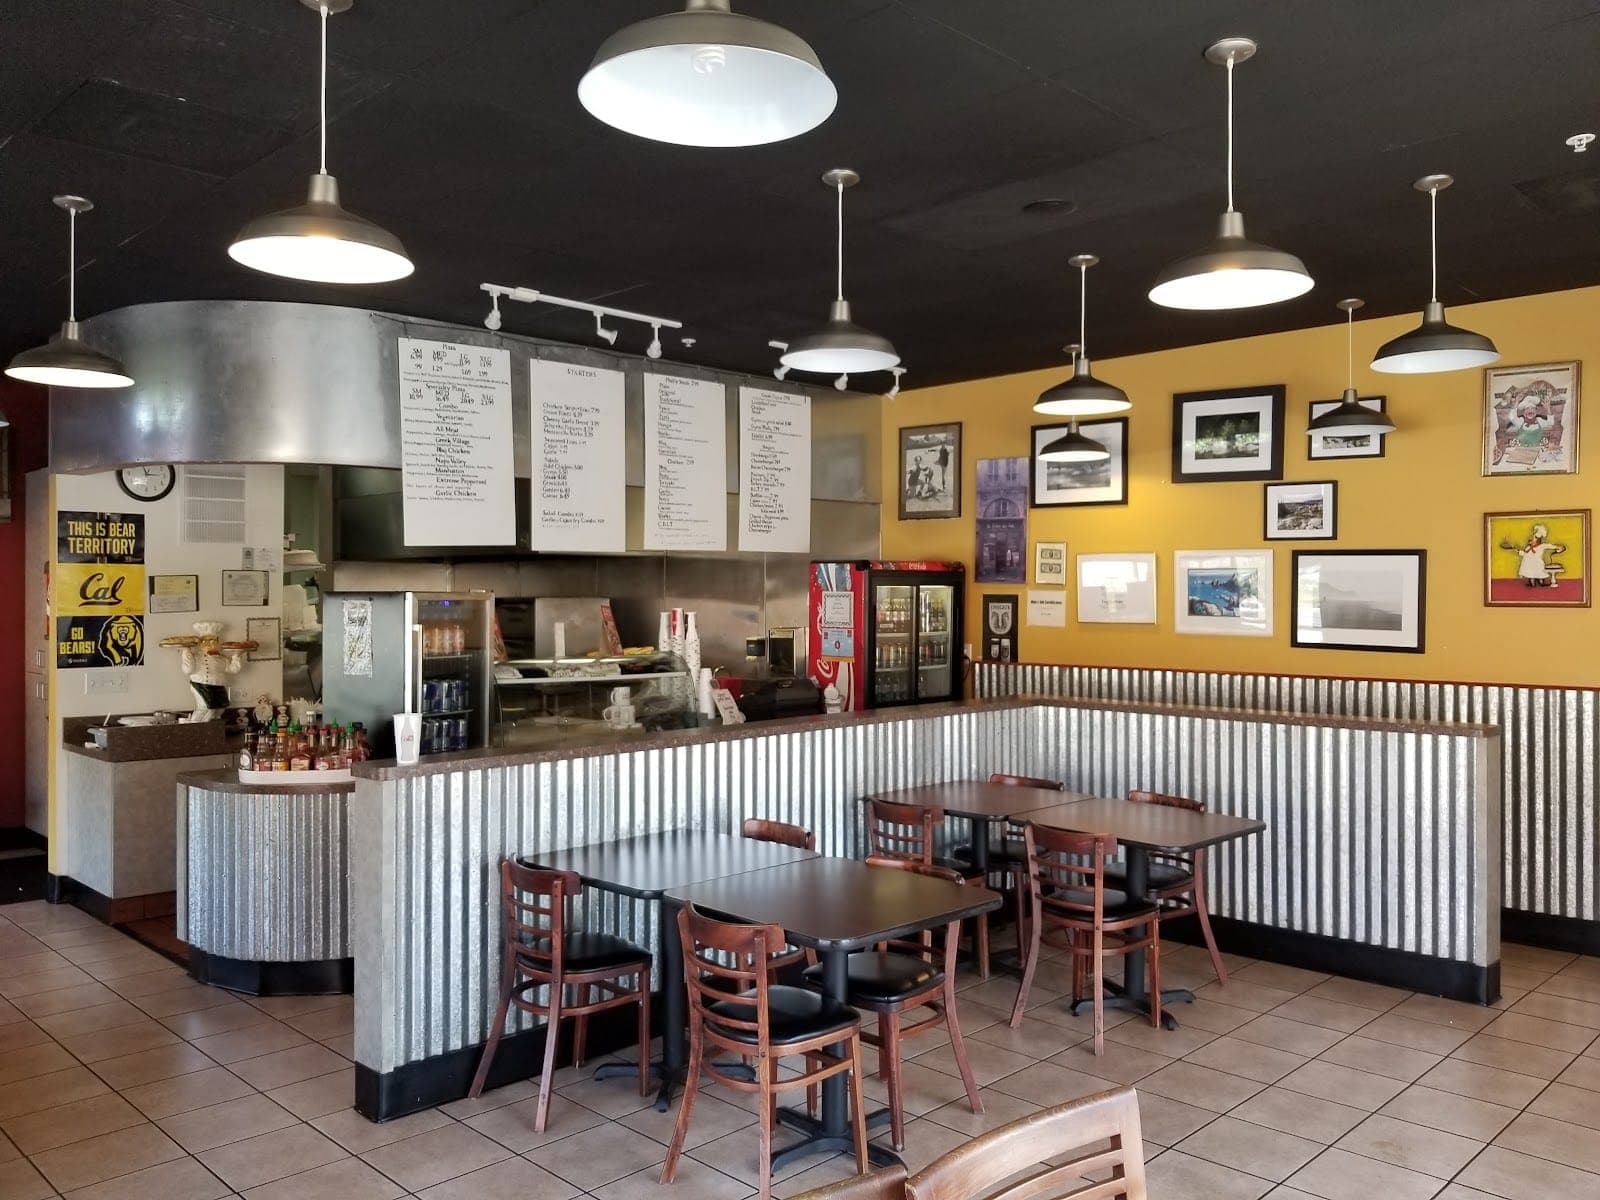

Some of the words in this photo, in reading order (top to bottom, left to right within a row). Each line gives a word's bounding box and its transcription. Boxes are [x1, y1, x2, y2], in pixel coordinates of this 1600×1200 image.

[568, 368, 597, 377] STARTERS
[436, 413, 464, 421] Vegetarian
[68, 521, 92, 536] THIS
[96, 522, 106, 536] IS
[109, 523, 136, 538] BEAR
[68, 537, 136, 555] TERRITORY
[79, 573, 125, 605] Cal
[71, 627, 84, 640] GO
[60, 641, 95, 654] BEARS!
